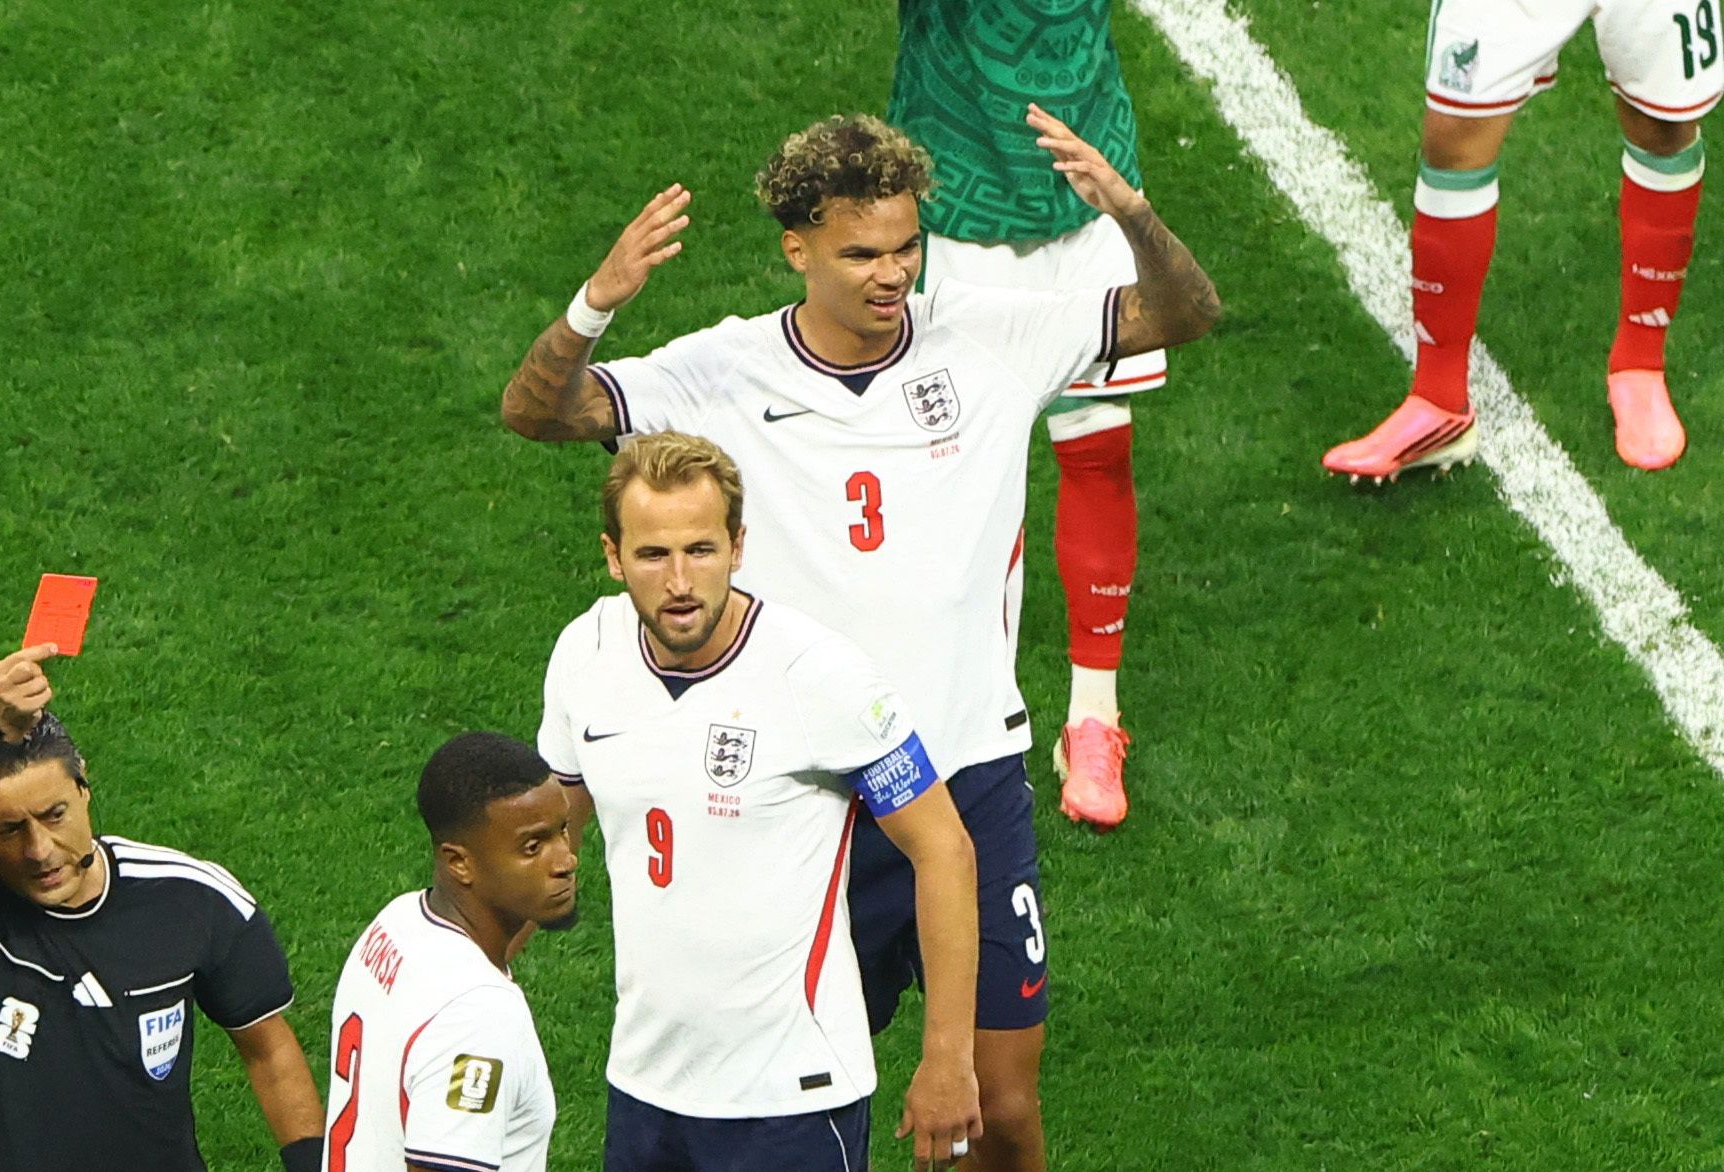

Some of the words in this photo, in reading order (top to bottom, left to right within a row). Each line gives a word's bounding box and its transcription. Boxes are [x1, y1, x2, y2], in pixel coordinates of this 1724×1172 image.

[1673, 0, 1717, 80] 19
[845, 470, 885, 552] 3
[862, 746, 908, 781] FOOTBALL
[867, 755, 914, 793] UNITES
[890, 766, 921, 795] World
[646, 807, 674, 888] 9
[359, 920, 404, 996] KONSA
[1011, 883, 1045, 964] 3
[146, 1007, 182, 1036] FIFA
